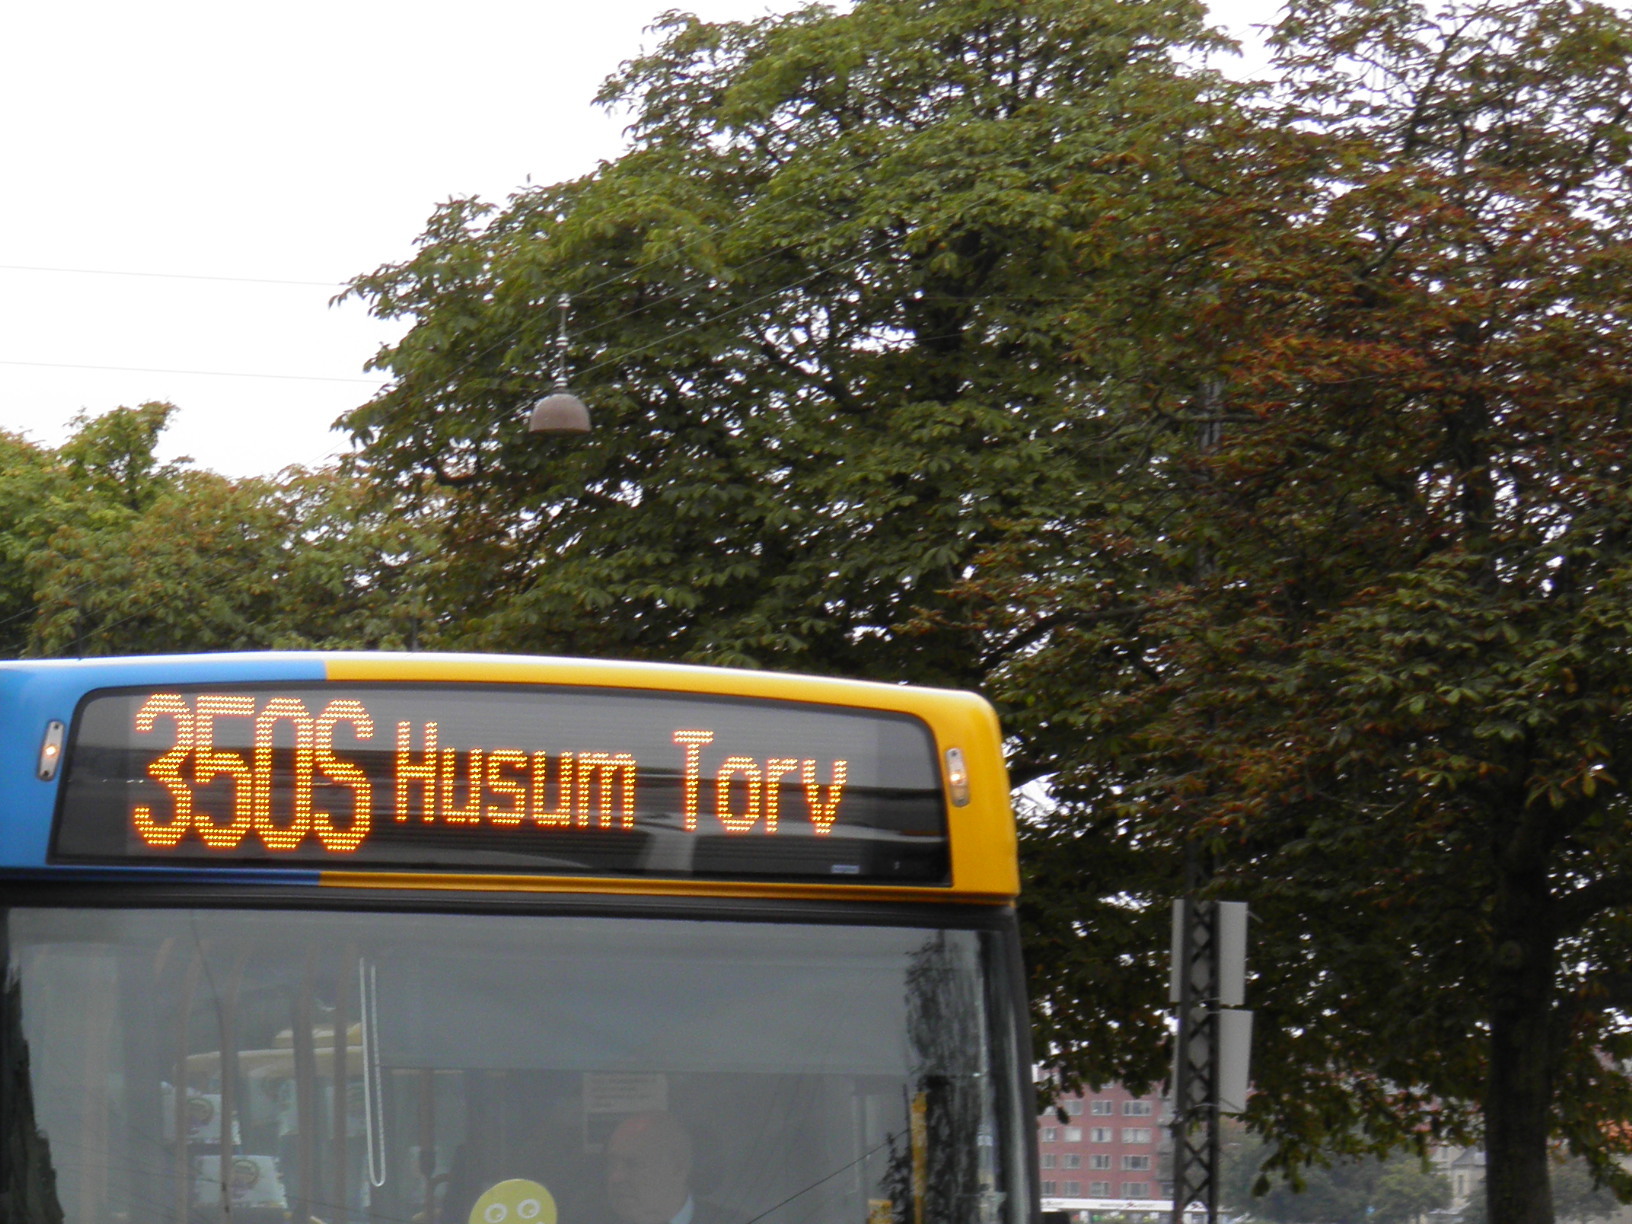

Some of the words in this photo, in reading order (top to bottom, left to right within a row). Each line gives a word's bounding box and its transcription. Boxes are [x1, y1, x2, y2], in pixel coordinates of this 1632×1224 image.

[133, 692, 375, 853] 350S
[394, 720, 637, 830] Husum
[671, 728, 848, 837] Torv
